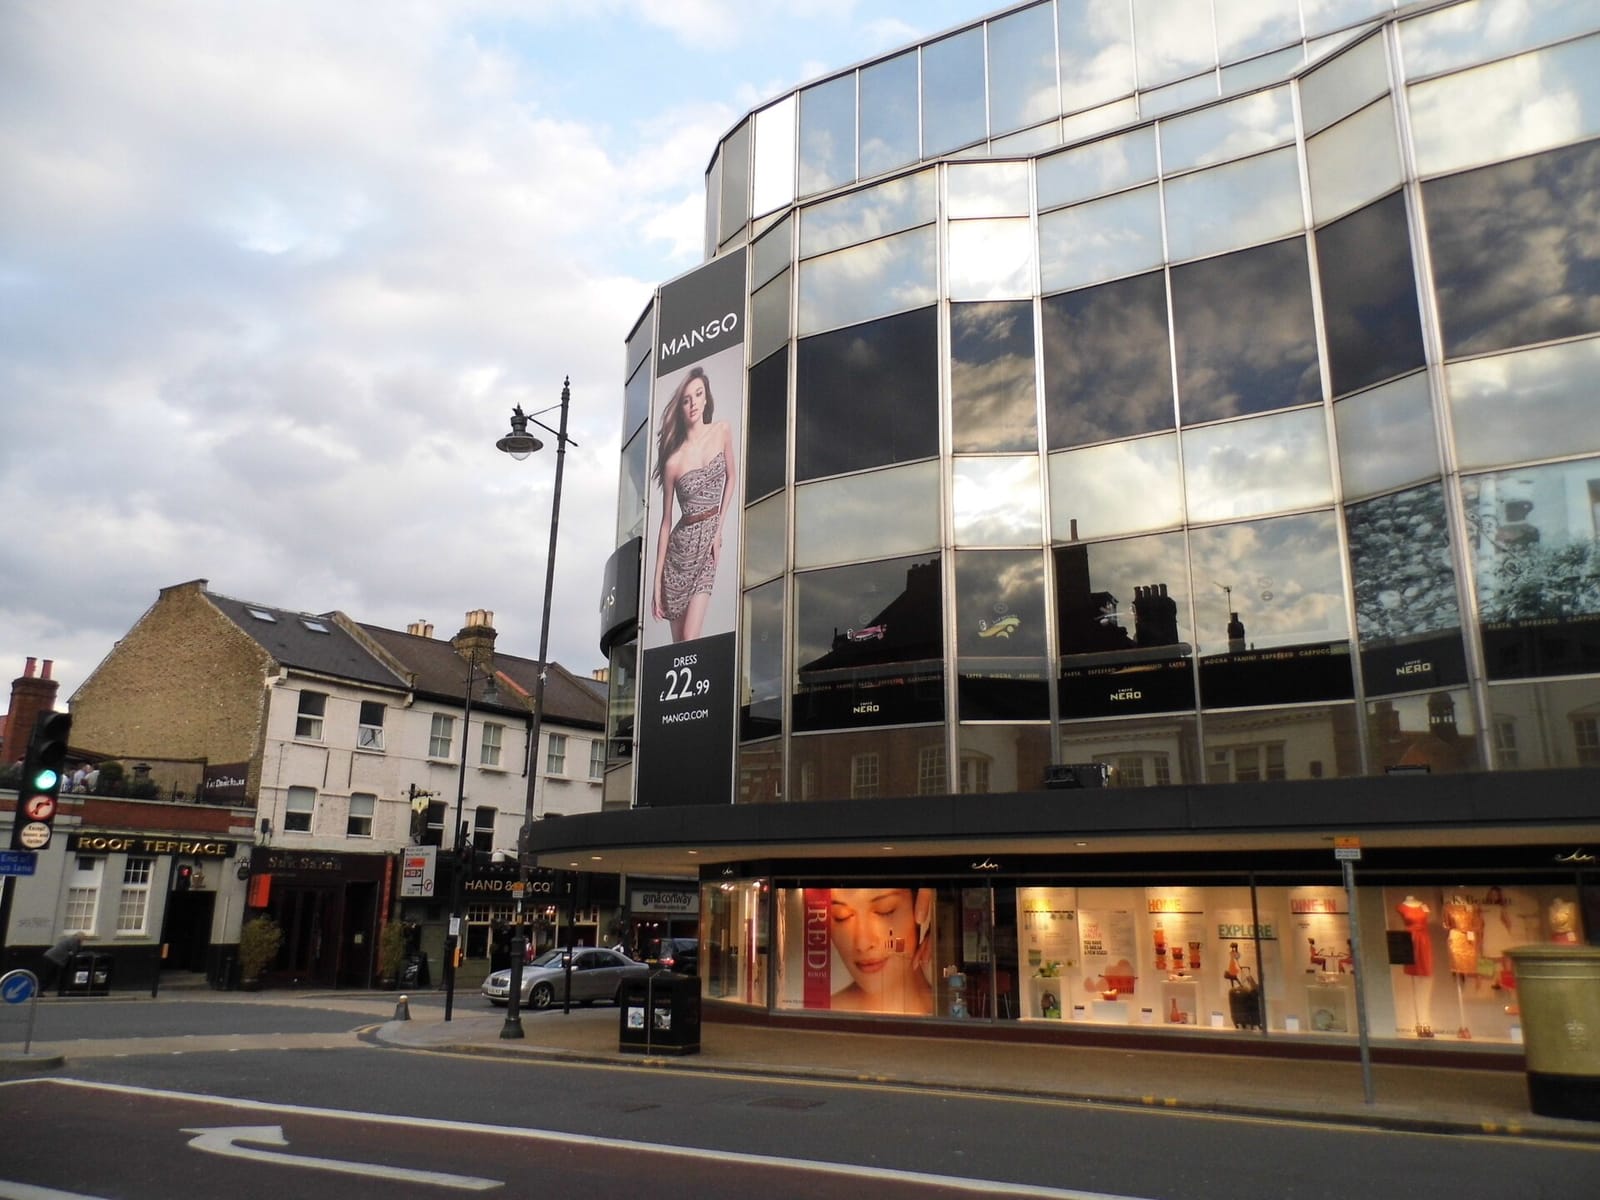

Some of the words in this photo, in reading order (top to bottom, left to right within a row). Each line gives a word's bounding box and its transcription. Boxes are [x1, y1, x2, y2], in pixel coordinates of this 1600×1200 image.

[661, 312, 738, 360] MANGO
[673, 654, 698, 668] DRESS
[1396, 662, 1432, 676] NERO
[660, 667, 710, 702] £22.99
[1110, 691, 1142, 701] NERO
[853, 705, 880, 714] NERO
[662, 709, 709, 725] MANGO.COM
[78, 837, 135, 852] ROOF
[143, 840, 228, 855] TERRACE
[465, 880, 503, 891] HAND
[1148, 899, 1181, 911] HOME
[1291, 899, 1336, 912] DINE-IN
[807, 906, 828, 969] RED
[1218, 924, 1273, 937] EXPLORE
